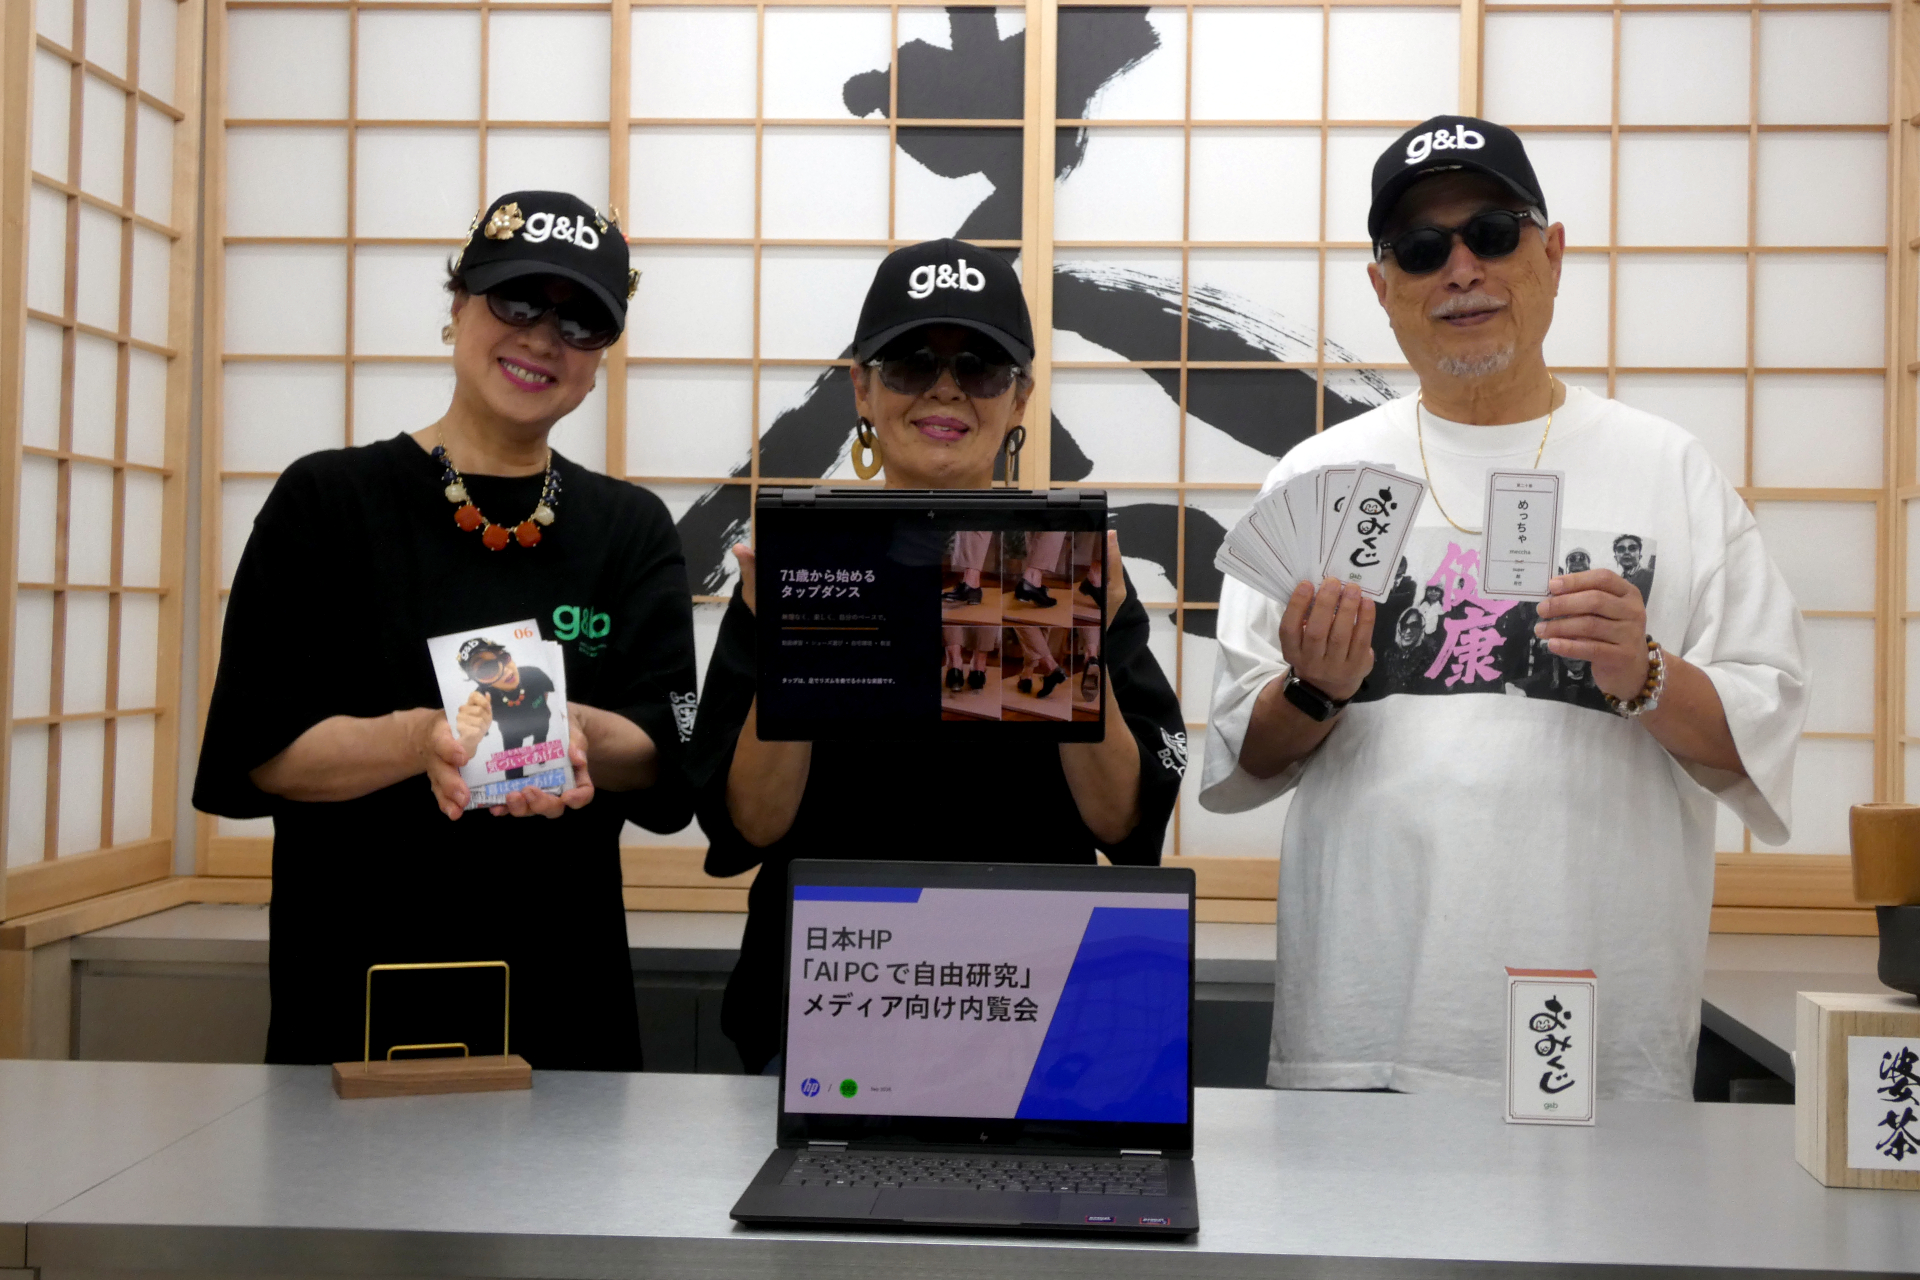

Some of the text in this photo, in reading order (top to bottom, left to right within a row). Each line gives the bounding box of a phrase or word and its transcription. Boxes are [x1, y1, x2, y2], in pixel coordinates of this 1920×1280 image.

[1405, 124, 1485, 165] g&b
[521, 212, 599, 250] g&b
[907, 259, 986, 299] g&b
[1349, 486, 1397, 567] おみくじ
[1517, 500, 1529, 543] めっちゃ
[780, 569, 876, 583] 71歳から始める
[781, 584, 861, 598] タップダンス
[514, 627, 533, 639] 06
[806, 927, 893, 951] 日本HP
[803, 992, 1039, 1023] メディア向け内覧会
[1529, 995, 1576, 1094] おみくじ
